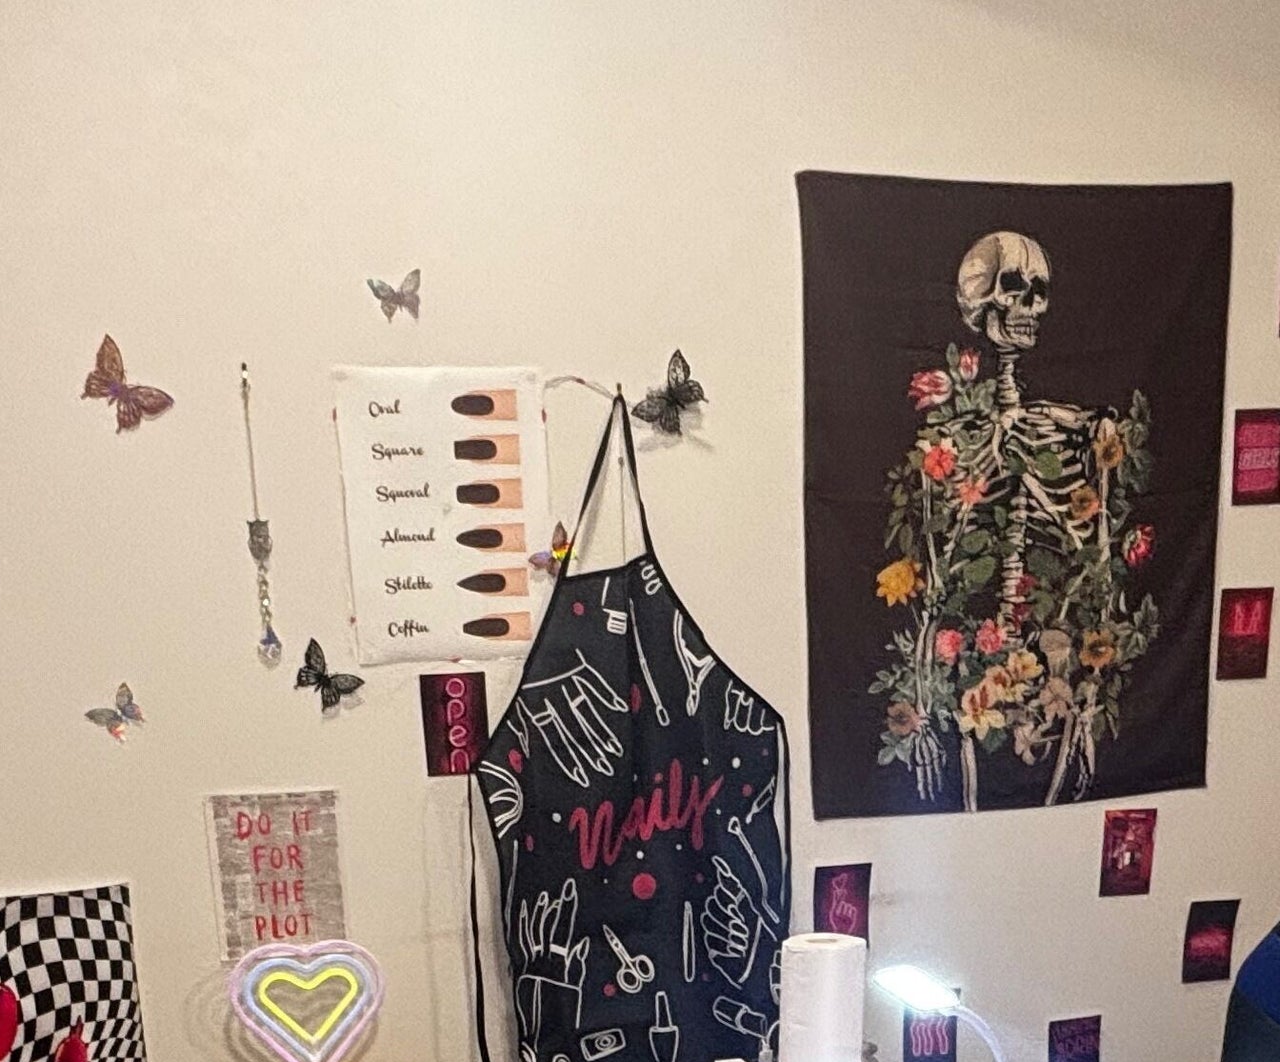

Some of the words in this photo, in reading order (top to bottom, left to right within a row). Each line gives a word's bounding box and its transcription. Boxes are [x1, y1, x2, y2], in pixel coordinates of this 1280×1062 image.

[368, 399, 401, 418] Oval
[371, 443, 424, 461] Square
[380, 527, 437, 548] Almond
[384, 576, 434, 595] Stiletto
[388, 619, 430, 638] Coffin
[237, 811, 271, 841] DO
[293, 809, 313, 836] IT
[253, 844, 304, 875] FOR
[255, 880, 305, 906] THE
[255, 913, 314, 941] PLOT
